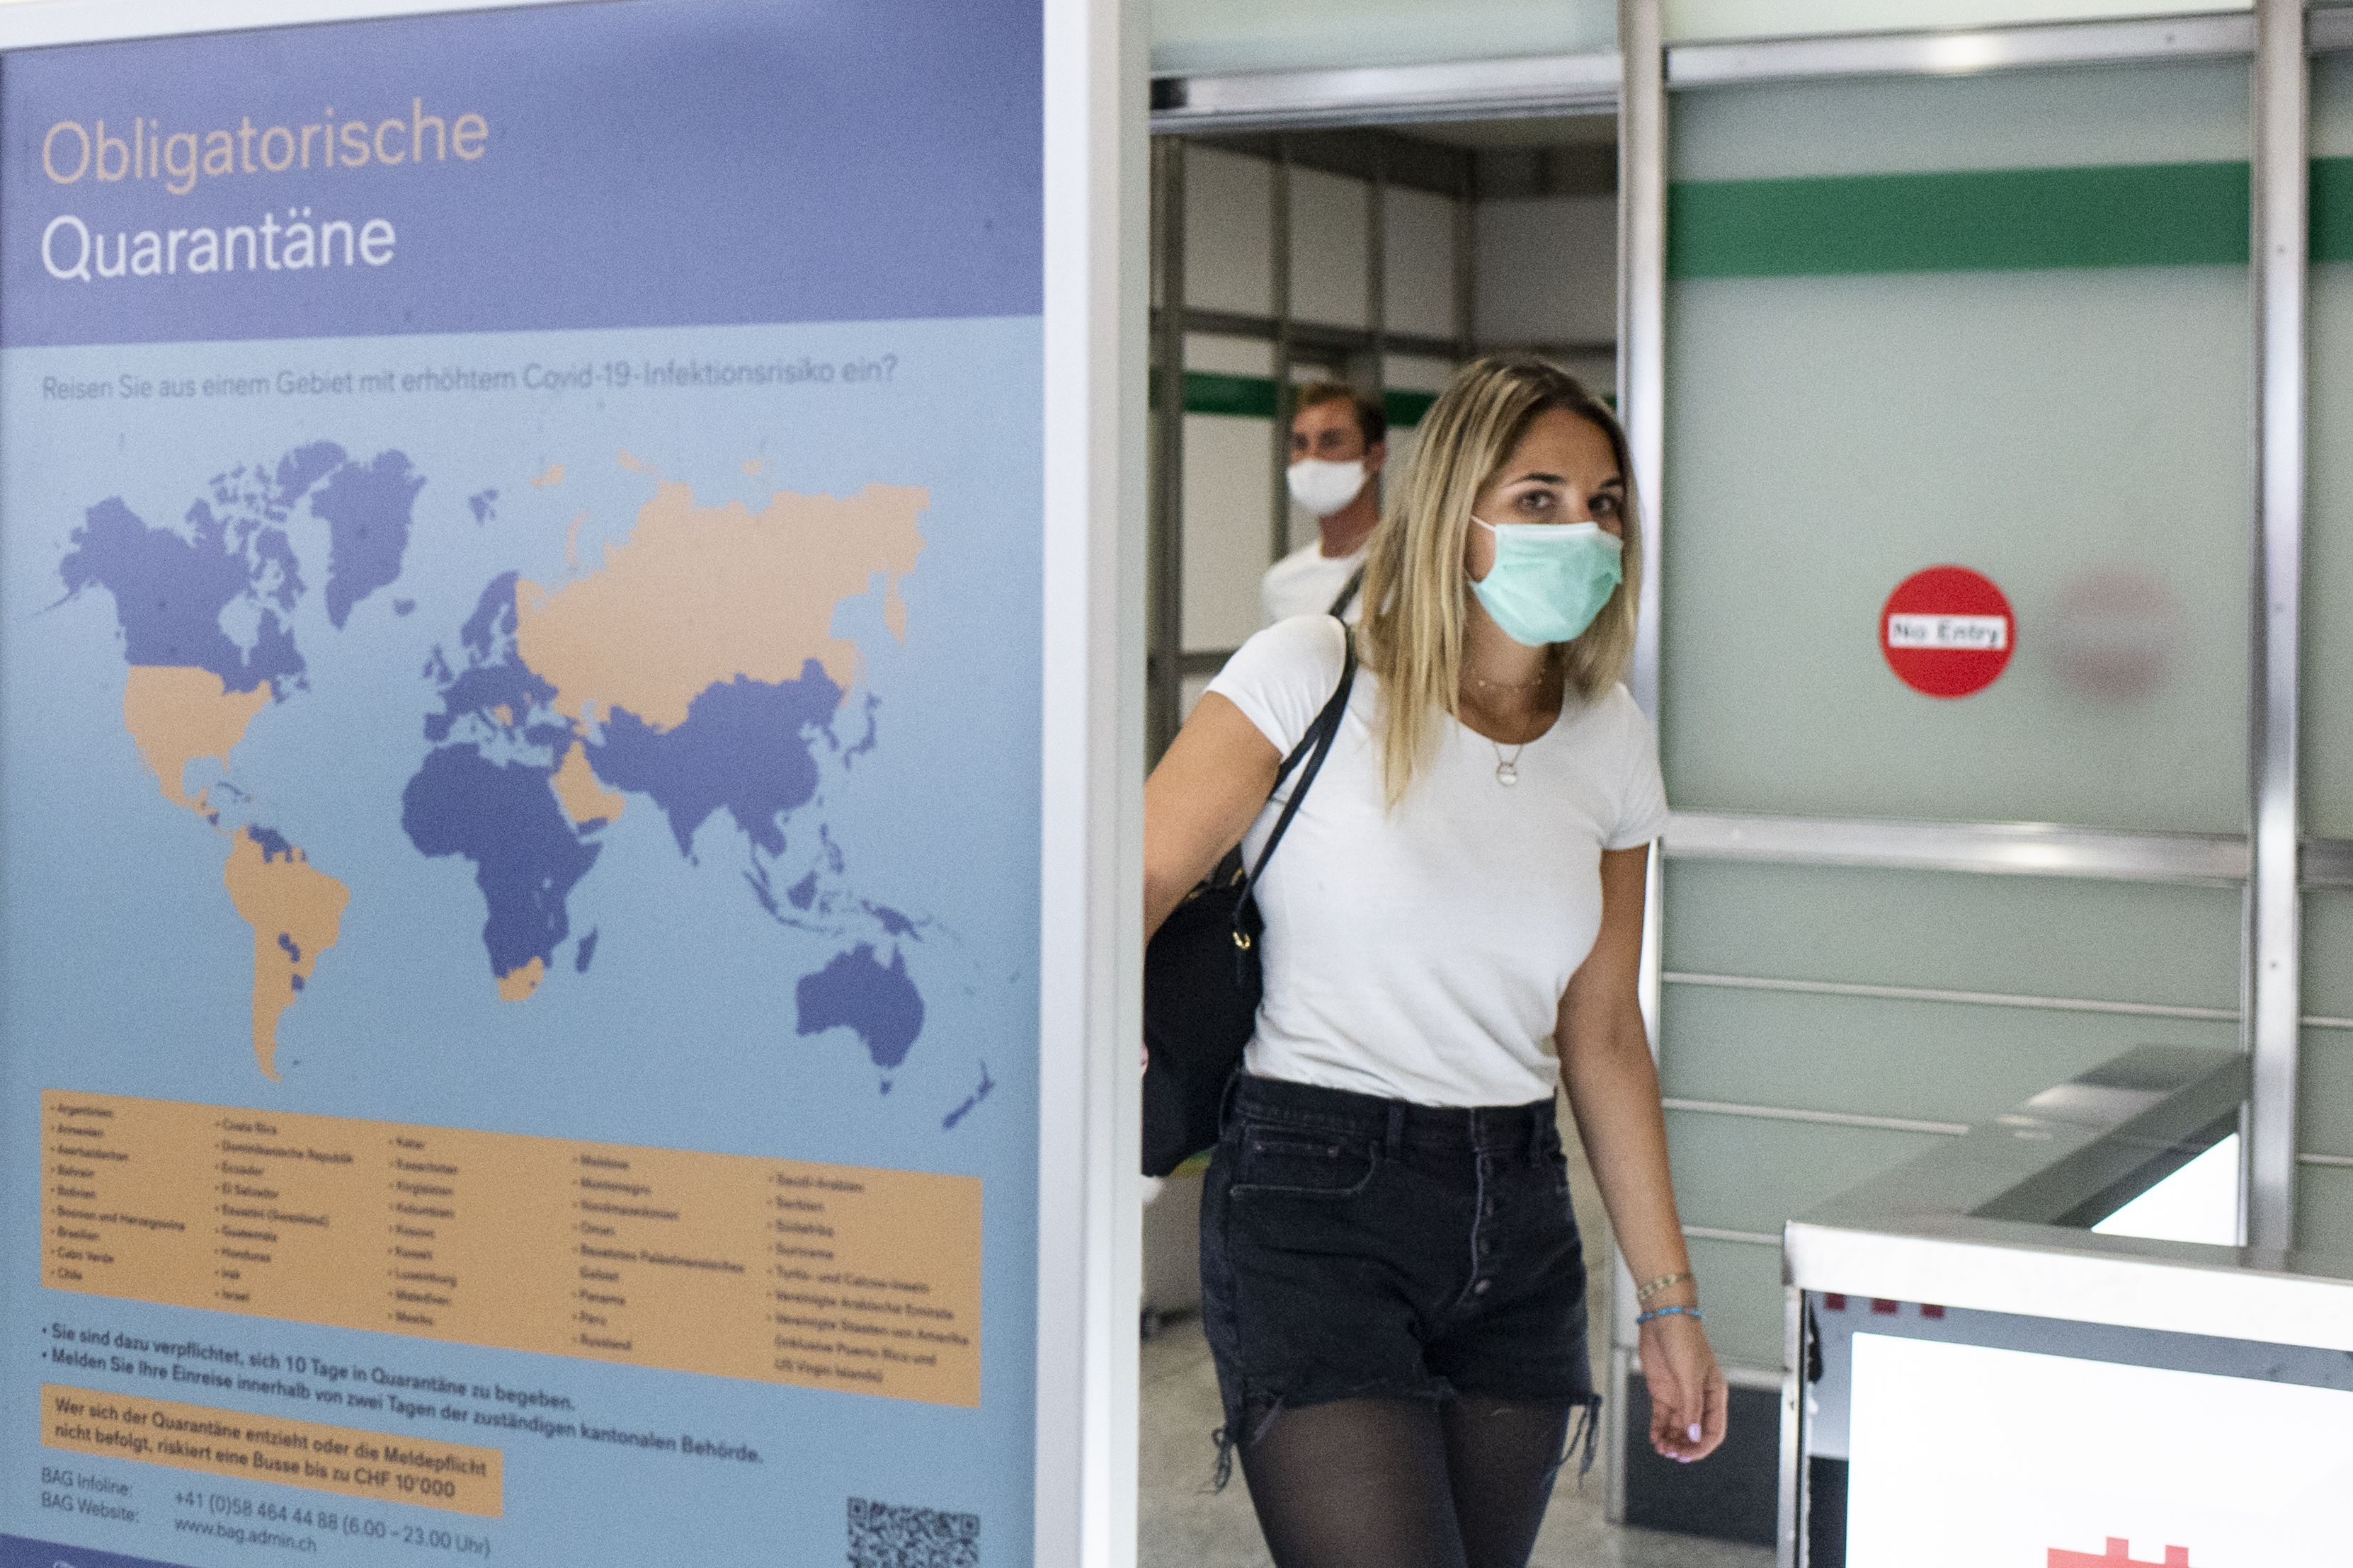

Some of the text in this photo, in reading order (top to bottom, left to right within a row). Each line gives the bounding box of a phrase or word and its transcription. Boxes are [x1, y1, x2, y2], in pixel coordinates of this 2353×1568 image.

[42, 96, 490, 196] Obligatorische
[41, 207, 397, 283] Quarantäne
[42, 353, 899, 400] Reisen Sie aus einem Gebiet mit erhöhtem Covid-19-Infektionsrisiko ein?
[1894, 622, 2000, 648] No Entry
[52, 1322, 576, 1412] Sie sind dazu verpflichtet, sich 10 Tage in Quarantäne zu begeben.
[52, 1346, 765, 1465] Melden Sie Ihre Einreise innerhalb von zwei Tagen der zuständigen kantonalen Behörde.
[55, 1396, 488, 1478] Wer sich der Quarantäne entzieht oder die Meldepflicht
[41, 1466, 133, 1497] BAG Infoline:
[55, 1422, 92, 1442] nicht
[94, 1428, 154, 1455] befolgt,
[157, 1438, 212, 1462] riskiert
[215, 1446, 249, 1466] eine
[251, 1449, 300, 1475] Busse
[304, 1458, 329, 1479] bis
[332, 1467, 352, 1483] zu
[353, 1466, 391, 1487] CHF
[41, 1490, 139, 1524] BAG Website:
[174, 1489, 205, 1509] +41
[207, 1492, 253, 1517] (0)58
[256, 1504, 287, 1523] 464
[292, 1506, 313, 1527] 44
[317, 1510, 338, 1531] 88
[341, 1513, 387, 1539] (6.00
[402, 1524, 452, 1550] 23.00
[455, 1533, 492, 1560] Uhr)
[174, 1517, 319, 1554] www.bag.admin.ch
